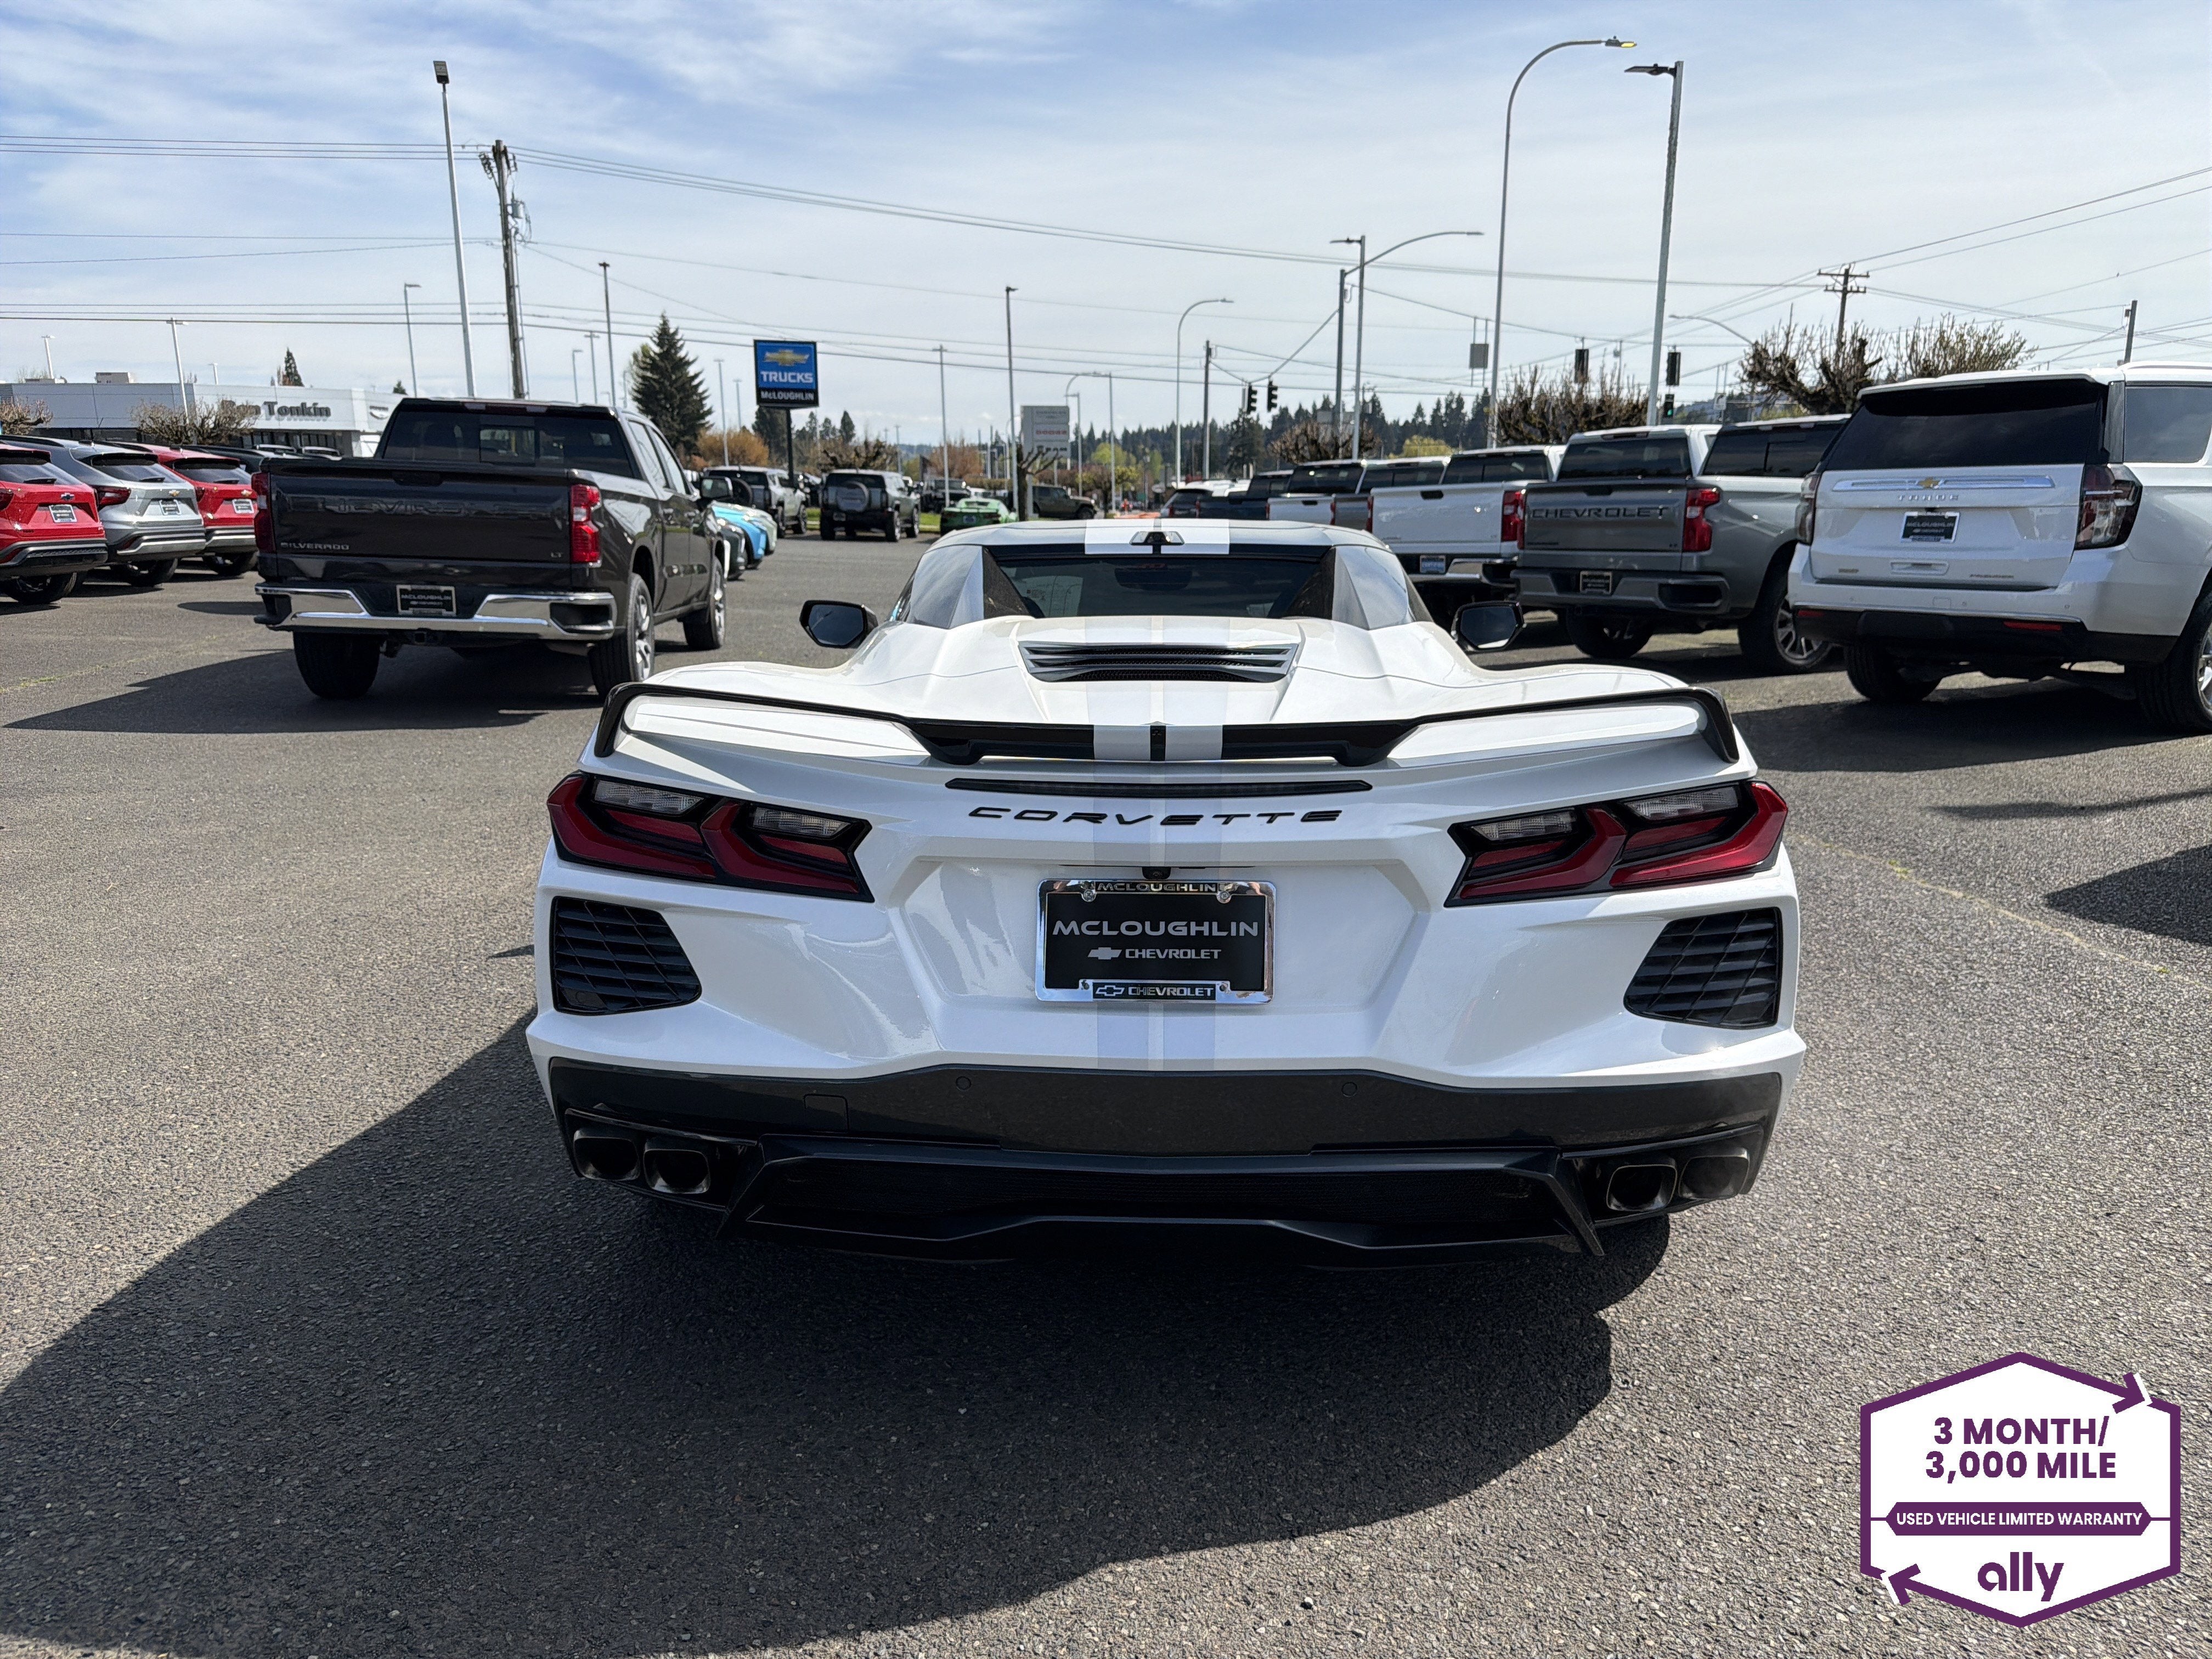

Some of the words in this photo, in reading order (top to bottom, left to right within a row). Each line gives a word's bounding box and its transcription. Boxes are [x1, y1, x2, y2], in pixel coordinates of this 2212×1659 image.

[760, 371, 813, 383] TRUCKS
[760, 391, 814, 400] McLOUGHLIN
[263, 400, 331, 417] Tonkin
[1532, 506, 1669, 519] CHEVROLET
[280, 541, 350, 550] SILVERADO
[968, 806, 1342, 826] CORVETTE
[1097, 882, 1216, 893] MCLOUGHLIN
[1052, 920, 1259, 937] MCLOUGHLIN
[1125, 948, 1222, 960] CHEVROLET
[1128, 986, 1214, 997] CHEVROLET
